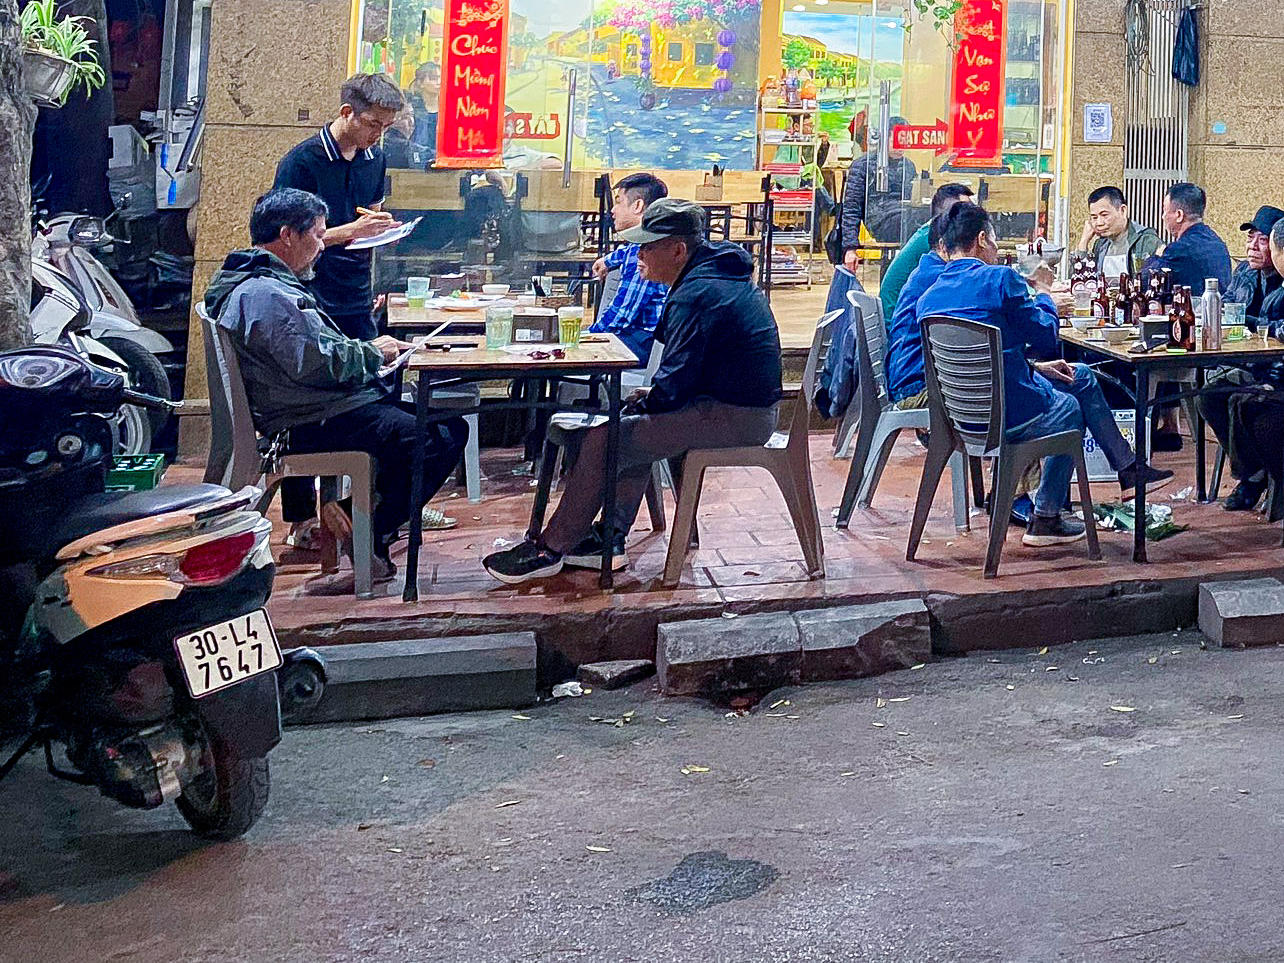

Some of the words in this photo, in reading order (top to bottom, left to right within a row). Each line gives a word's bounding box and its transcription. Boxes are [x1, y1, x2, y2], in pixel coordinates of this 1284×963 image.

[451, 33, 498, 56] Chúc
[189, 616, 258, 660] 30-L4
[198, 643, 262, 689] 7647
